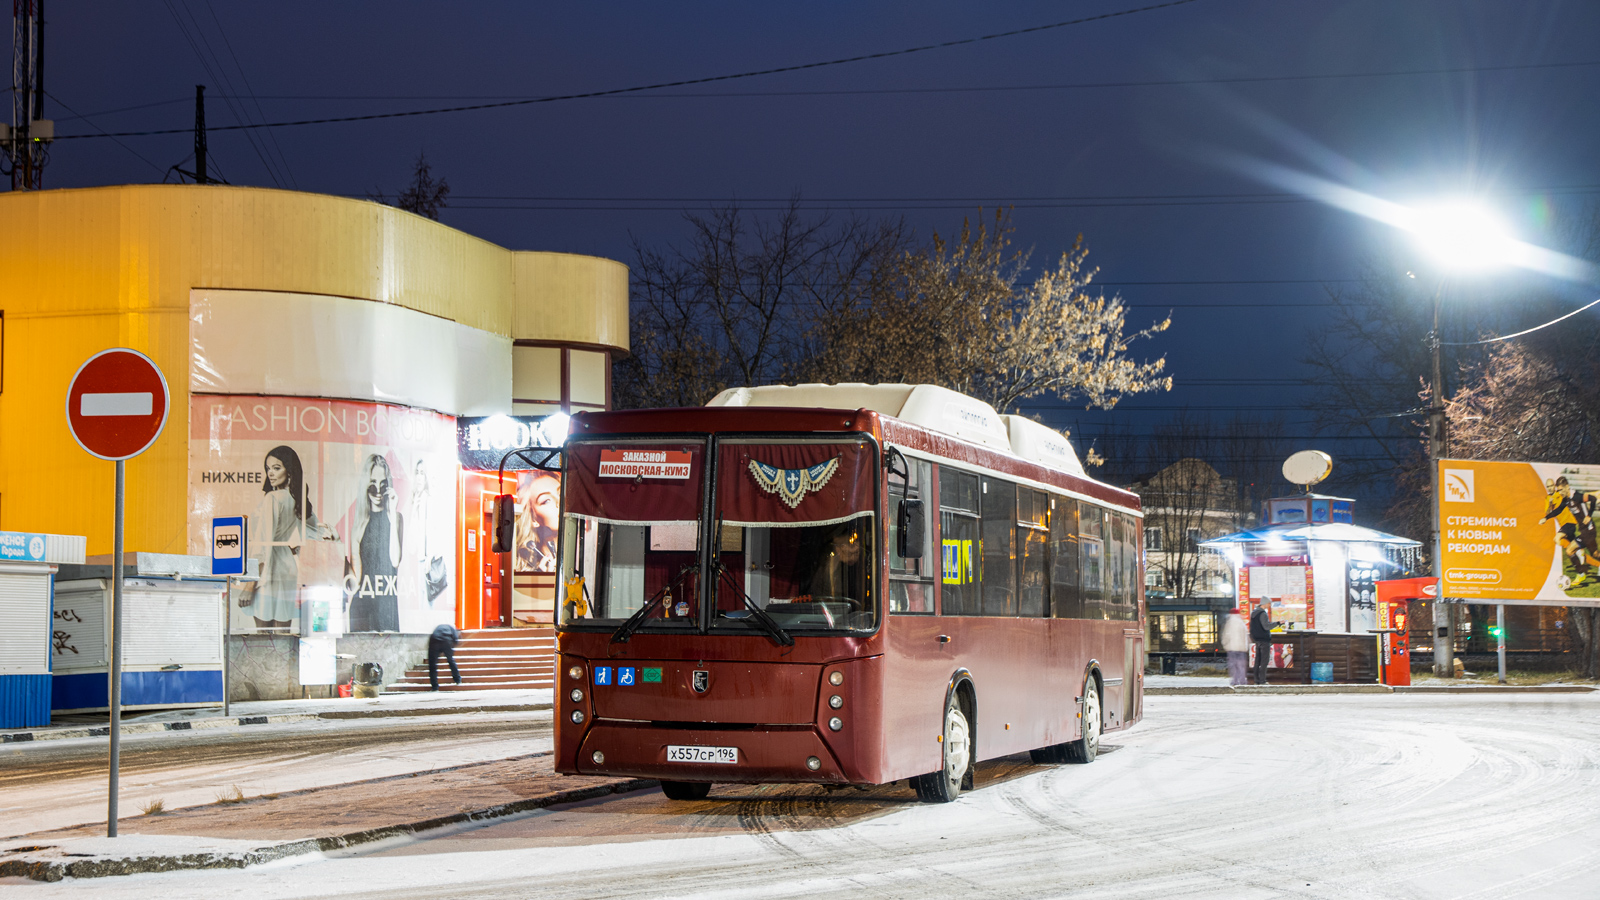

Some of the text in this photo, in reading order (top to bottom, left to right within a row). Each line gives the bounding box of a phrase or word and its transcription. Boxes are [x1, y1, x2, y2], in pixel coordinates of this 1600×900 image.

[210, 405, 346, 433] FASHION
[622, 451, 667, 463] ЗАКАЗНОЙ
[600, 464, 689, 477] МОСКОВСКАЯ-КУМЗ
[202, 472, 262, 484] НИЖНЕЕ
[1446, 516, 1517, 527] СТРЕМИМСЯ
[1447, 530, 1502, 540] К НОВЫМ
[1448, 543, 1511, 555] РЕКОРДАМ
[1448, 572, 1497, 580] tmk-group.ru
[717, 749, 735, 758] 196
